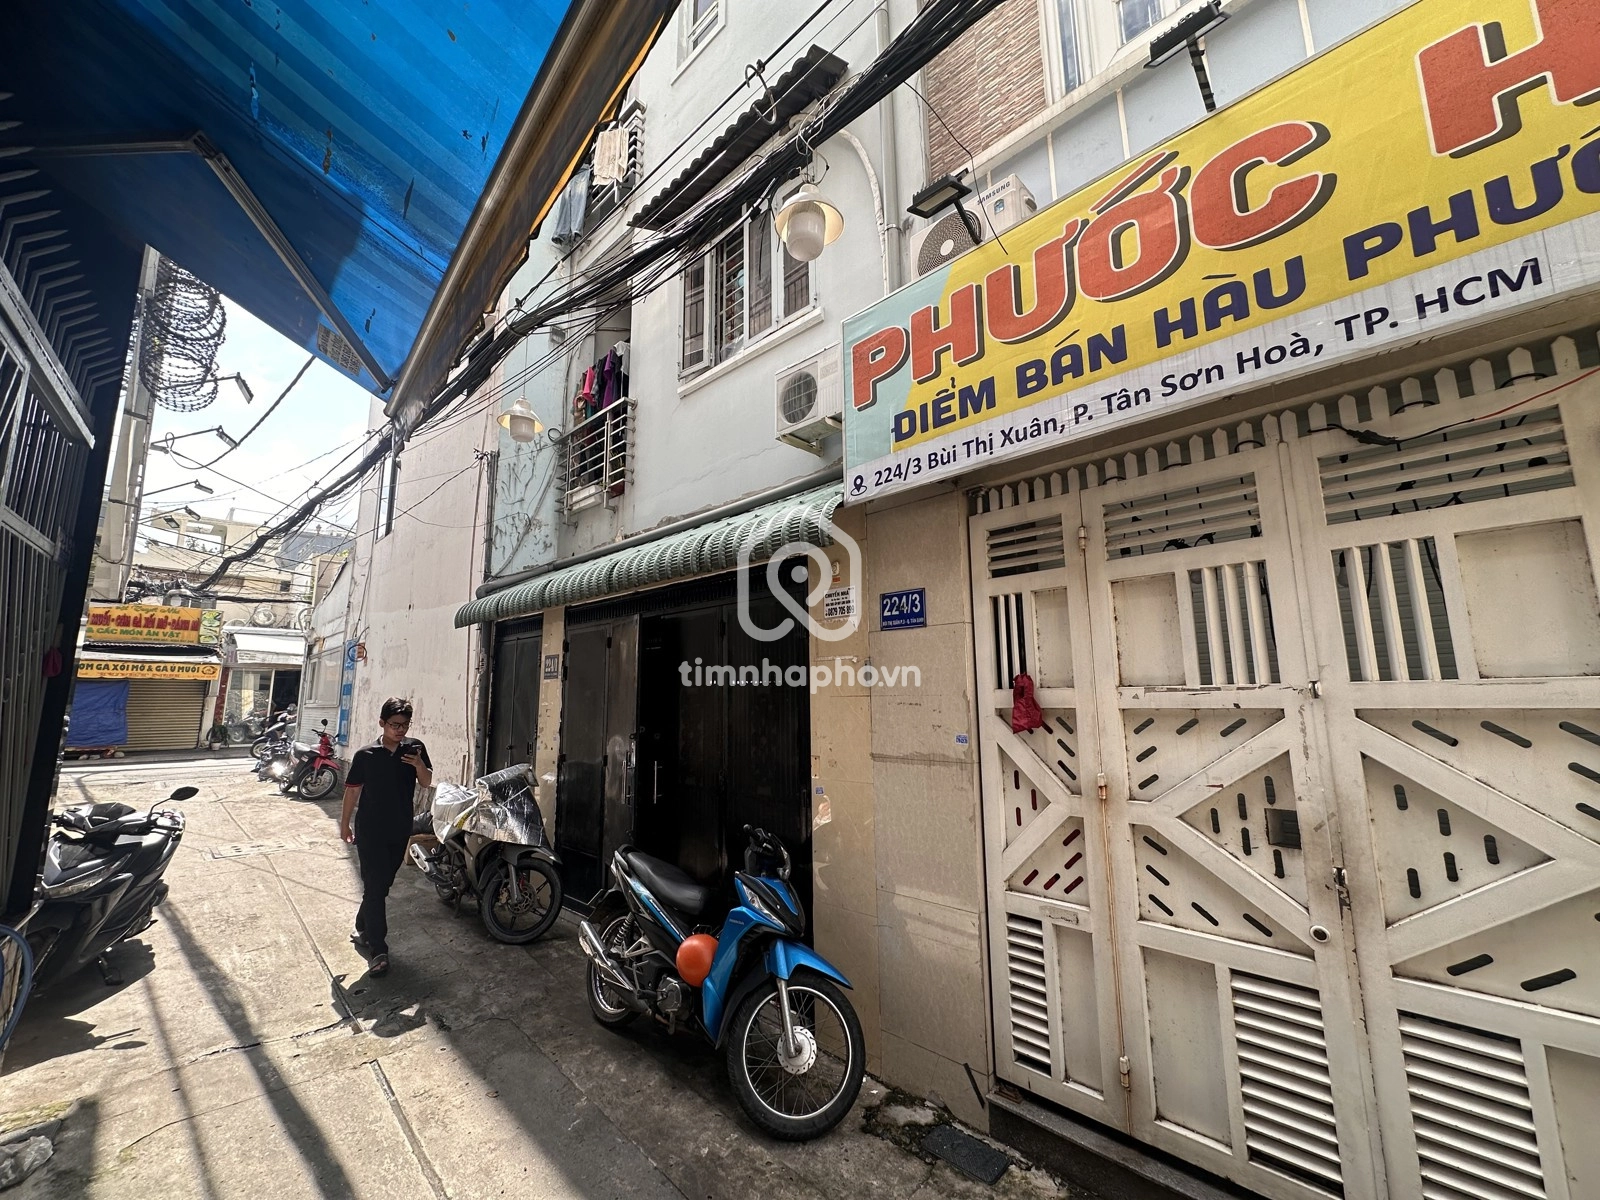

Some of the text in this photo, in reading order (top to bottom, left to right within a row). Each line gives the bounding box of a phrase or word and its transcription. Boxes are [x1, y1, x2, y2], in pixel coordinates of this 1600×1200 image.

[852, 119, 1337, 411] PHƯỚC
[977, 181, 1011, 206] SAMSUNG
[874, 257, 1543, 488] 224/3 Bùi Thị Xuân, P. Tân Sơn Hoà, TP. HCM
[890, 376, 997, 443] ĐIỂM
[1015, 324, 1128, 399] BÁN
[1153, 255, 1307, 349] HÀU
[883, 593, 921, 617] 224/3
